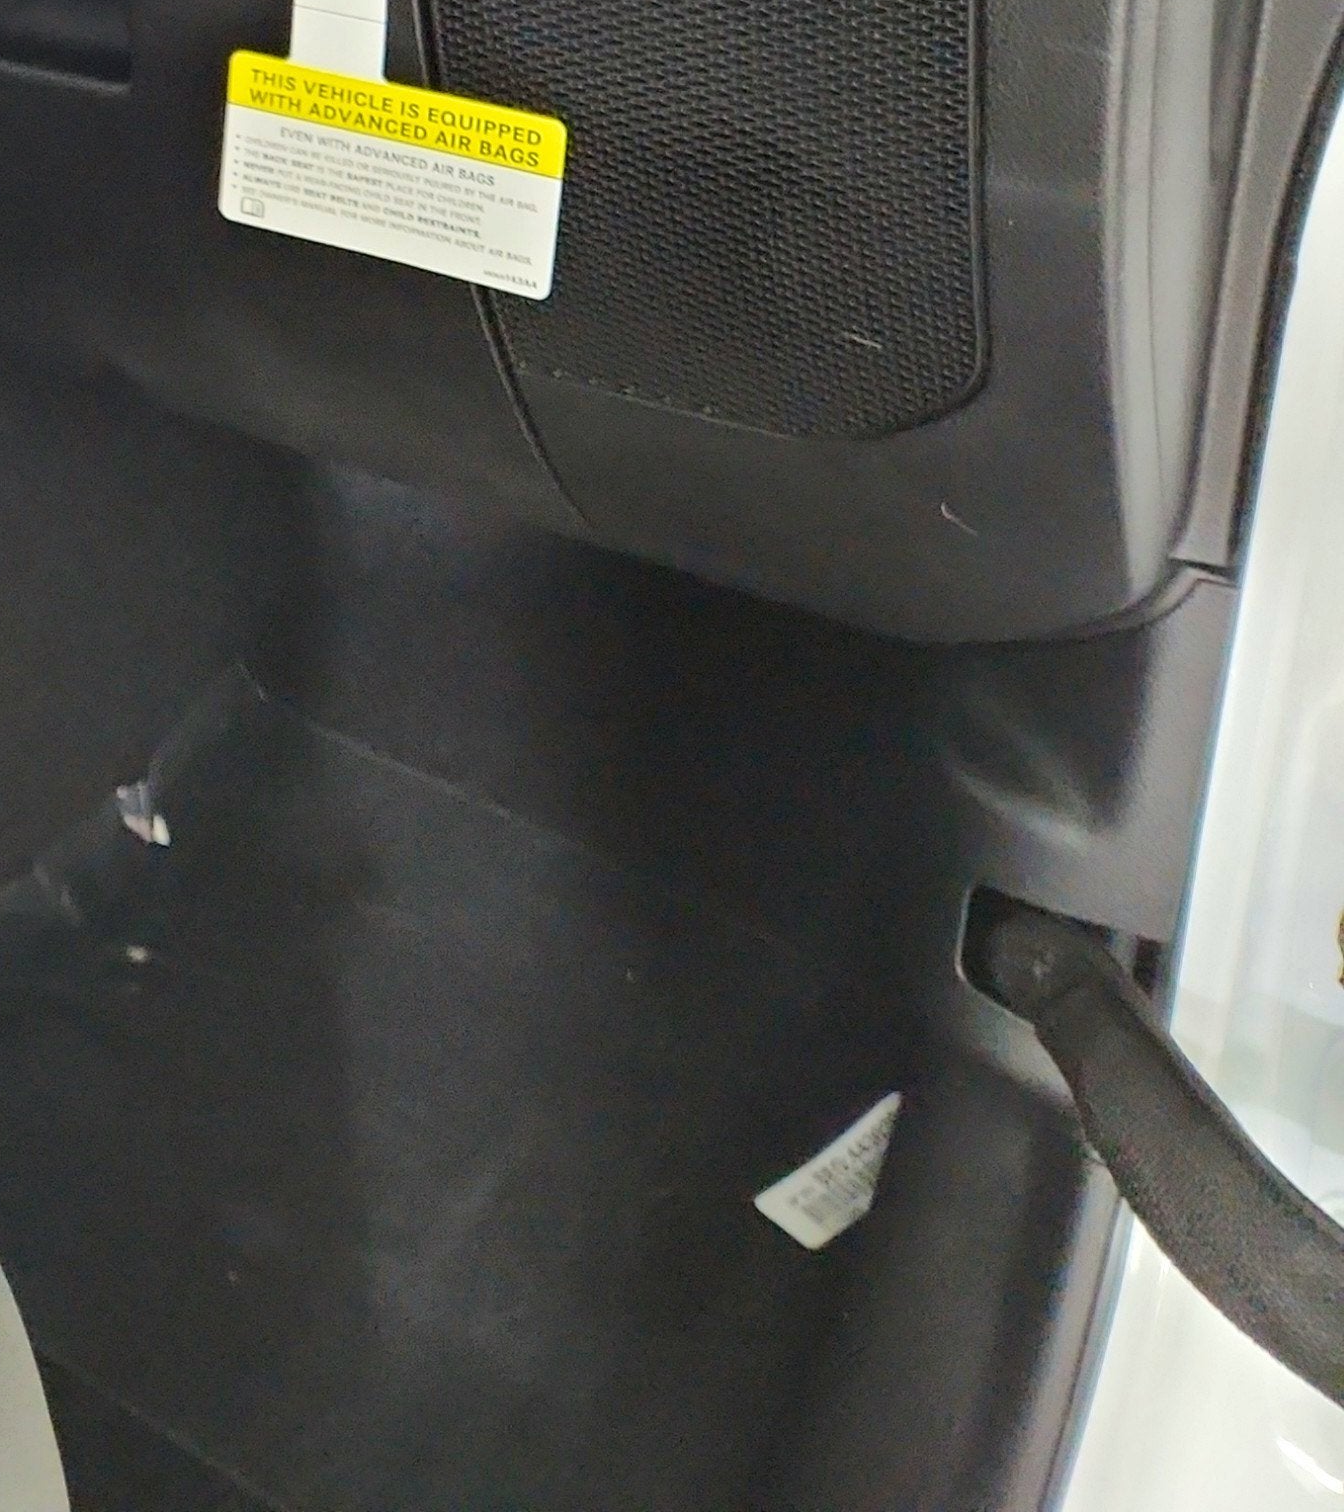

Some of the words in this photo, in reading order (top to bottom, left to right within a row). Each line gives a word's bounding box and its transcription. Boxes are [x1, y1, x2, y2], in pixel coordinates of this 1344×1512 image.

[248, 88, 301, 112] WITH
[309, 101, 427, 141] ADVANCED
[435, 129, 471, 151] AIR
[479, 140, 539, 167] BAGS
[250, 68, 296, 92] THIS
[302, 80, 393, 113] VEHICLE
[399, 101, 419, 118] IS
[427, 107, 541, 146] EQUIPPED
[280, 126, 312, 143] EVEN
[317, 134, 350, 152] WITH
[354, 143, 427, 170] ADVANCED
[432, 161, 454, 176] AIR
[458, 168, 494, 186] BAGS
